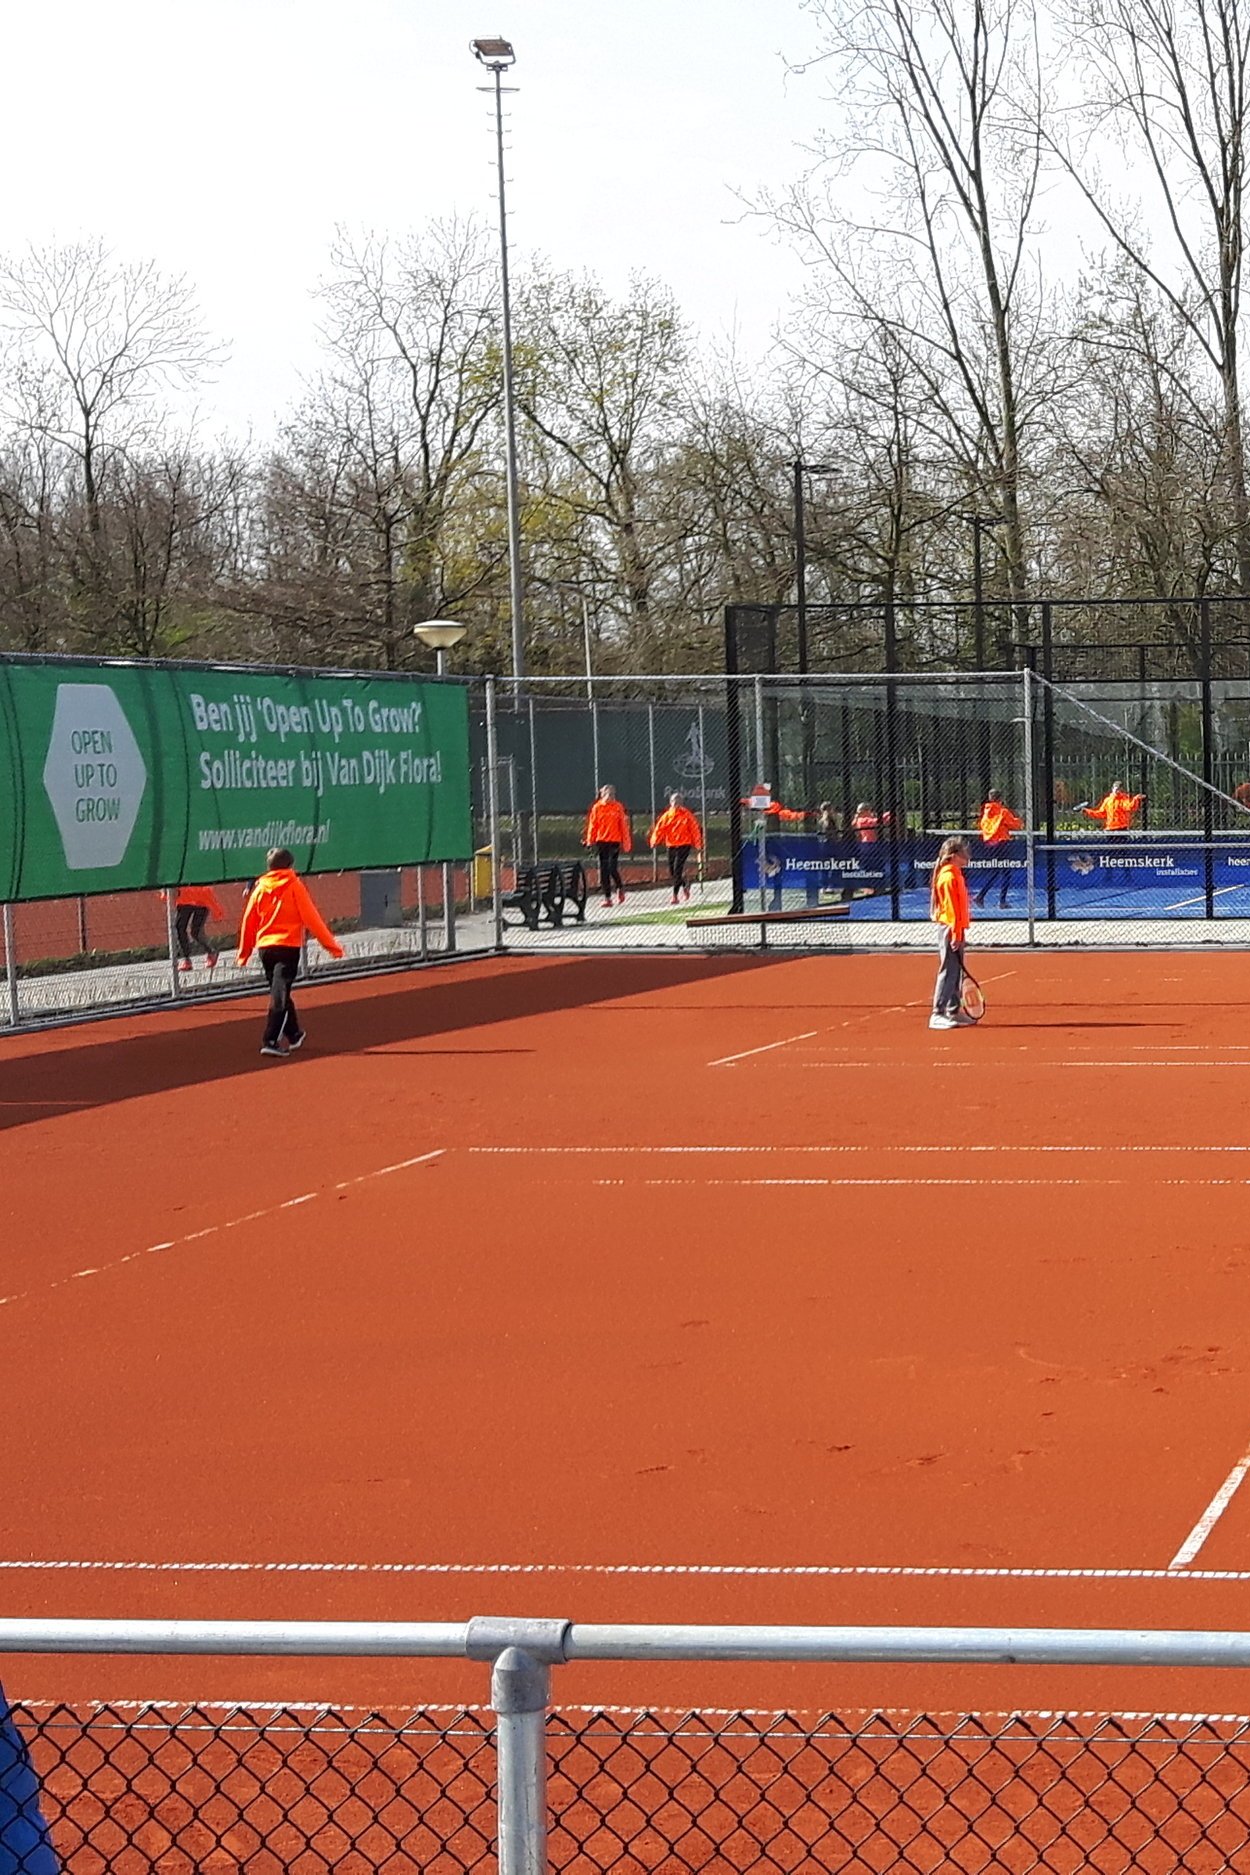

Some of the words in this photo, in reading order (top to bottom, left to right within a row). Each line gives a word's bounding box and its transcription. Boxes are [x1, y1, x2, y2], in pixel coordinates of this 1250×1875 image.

[190, 694, 233, 731] Ben
[233, 695, 257, 743] jij
[315, 699, 343, 743] Up
[342, 699, 365, 732] To
[71, 730, 113, 755] OPEN
[74, 763, 95, 788] UP
[97, 763, 118, 787] TO
[200, 750, 296, 790] Solliciteer
[301, 751, 324, 797] bij
[325, 750, 359, 785] Van
[362, 749, 396, 795] Dijk
[75, 797, 121, 823] GROW
[199, 818, 331, 851] www.vandijkflora.nl
[785, 858, 861, 872] Heemskerk
[1099, 856, 1175, 868] Heemskerk
